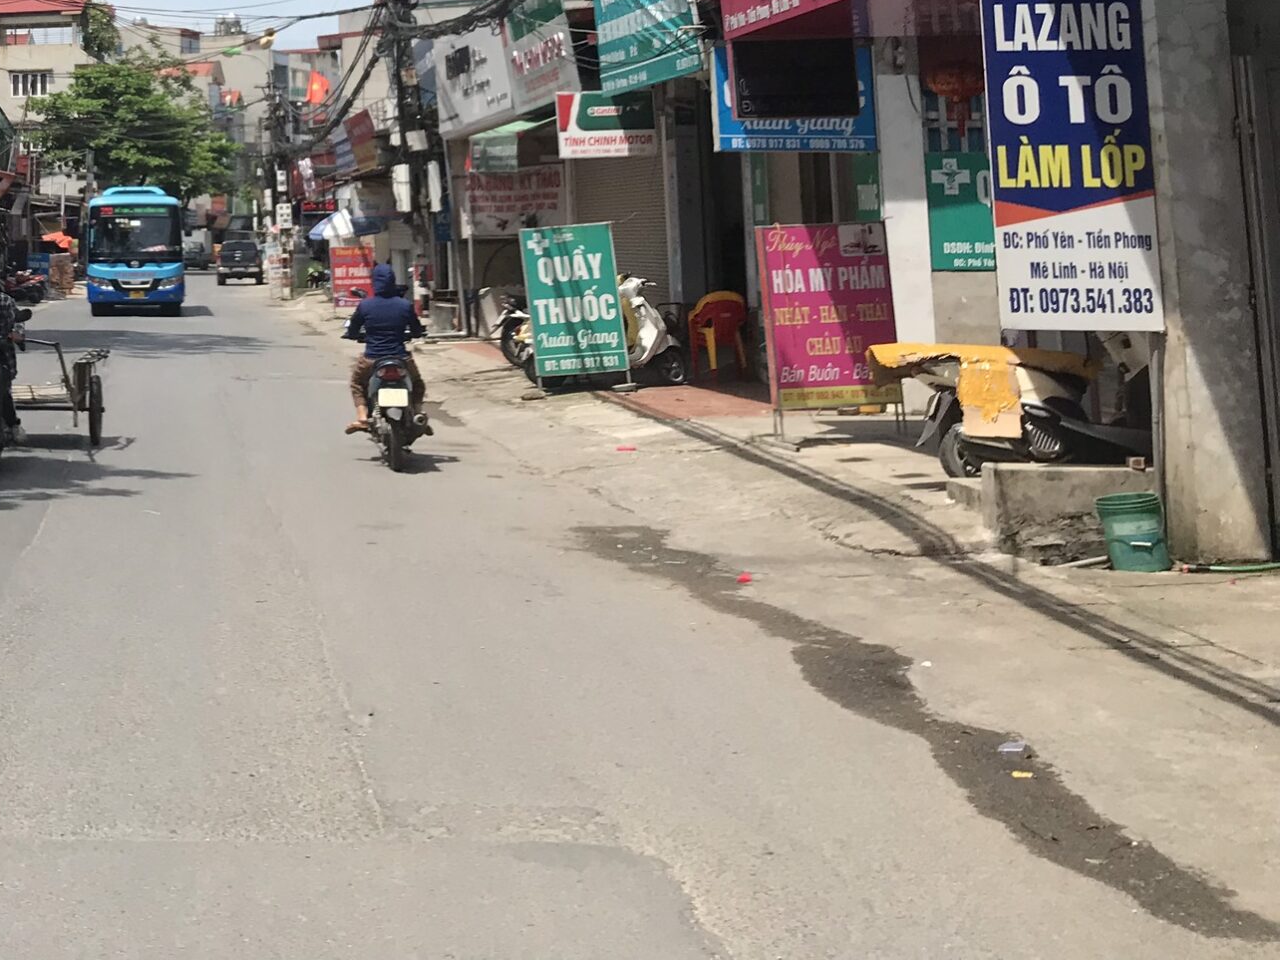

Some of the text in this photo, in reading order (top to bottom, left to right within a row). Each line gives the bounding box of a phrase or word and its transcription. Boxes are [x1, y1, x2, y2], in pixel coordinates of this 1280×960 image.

[993, 1, 1132, 52] LAZANG
[1002, 64, 1133, 125] Ô TÔ
[618, 134, 653, 145] MOTOR
[997, 128, 1146, 188] LÀM LỐP
[1003, 231, 1023, 249] ĐC:
[1026, 229, 1049, 249] Phố
[1053, 231, 1075, 249] Yên
[1114, 232, 1152, 250] Phong
[537, 245, 602, 286] QUẦY
[772, 256, 886, 294] HÓA MỸ PHẨM
[1030, 261, 1129, 283] Mê Linh Hà Nội
[533, 285, 617, 325] THUỐC
[1009, 287, 1154, 314] ĐT: 0973.541.383
[774, 302, 810, 329] NHẬT
[538, 328, 620, 349] Xuân Giang
[583, 356, 600, 368] 917
[780, 362, 840, 383] Bán Buôn
